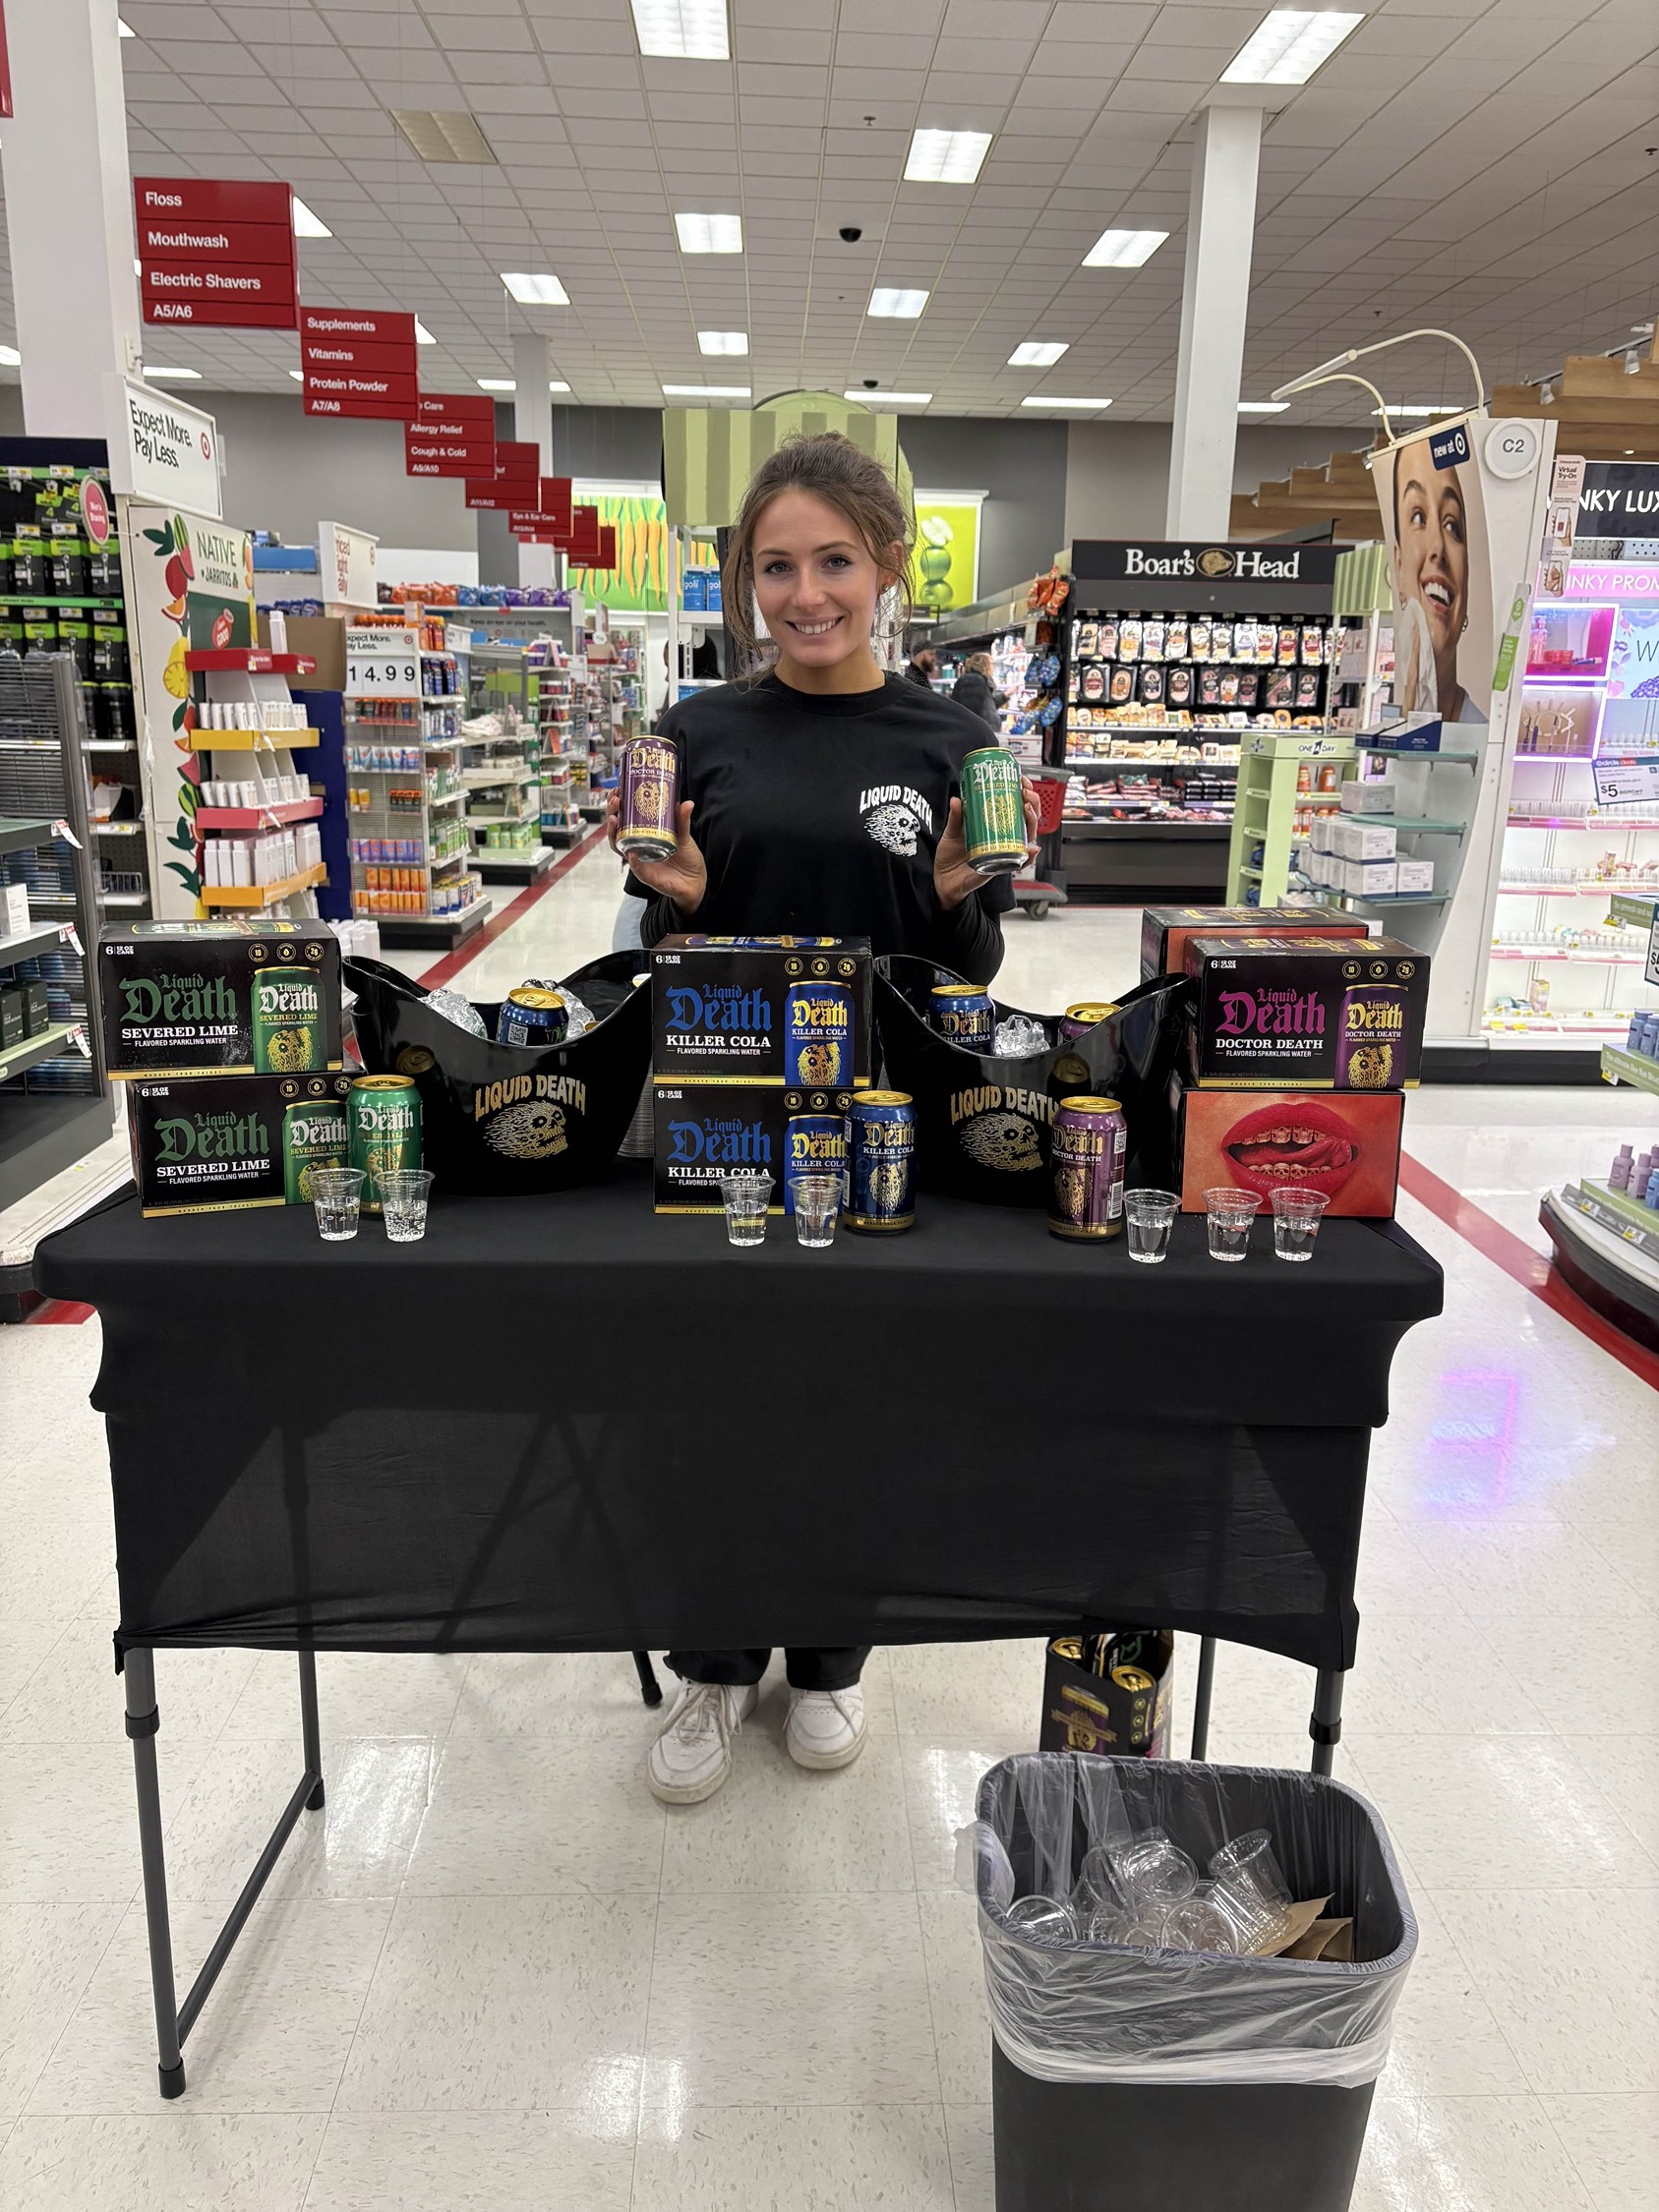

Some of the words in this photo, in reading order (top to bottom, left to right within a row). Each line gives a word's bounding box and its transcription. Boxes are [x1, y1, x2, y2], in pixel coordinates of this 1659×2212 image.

[146, 191, 182, 206] Floss
[148, 232, 228, 248] Mouthwash
[150, 271, 203, 287] Electric
[206, 273, 261, 290] Shavers
[153, 304, 193, 319] A5/A6
[307, 318, 376, 332] Supplements
[308, 348, 354, 361] Vitamins
[309, 378, 347, 390] Protein
[348, 379, 388, 392] Powder
[312, 400, 341, 412] A7/A8
[129, 399, 164, 437] Expect
[165, 415, 193, 447] More.
[410, 424, 439, 435] Allergy
[440, 425, 463, 435] Relief
[135, 430, 152, 462] Pay
[154, 439, 179, 468] Less.
[411, 446, 439, 457] Cough
[440, 447, 446, 456] &
[446, 448, 467, 457] Cold
[1434, 444, 1447, 458] new
[1447, 439, 1455, 453] at
[1503, 438, 1524, 453] C2
[1579, 489, 1622, 511] NKY
[197, 531, 237, 566] NATIVE
[1124, 548, 1195, 576] Boar's
[1234, 551, 1300, 579] Head
[205, 566, 232, 587] JARRITOS
[1566, 574, 1609, 591] INKY
[683, 580, 699, 590] goli
[709, 579, 721, 591] gol
[346, 634, 368, 644] xpect
[1600, 784, 1619, 797] $5
[859, 785, 902, 814] LIQUID
[903, 786, 933, 835] DEATH
[105, 946, 114, 955] 6
[160, 973, 204, 990] Liquid
[278, 983, 303, 992] Liquid
[119, 975, 238, 1023] Death
[259, 985, 319, 1014] Death
[702, 984, 741, 1000] Liquid
[1256, 987, 1297, 1004] Liquid
[665, 985, 773, 1031] Death
[810, 998, 834, 1008] Liquid
[1366, 1001, 1391, 1010] Liquid
[792, 1000, 848, 1026] Death
[1215, 990, 1326, 1035] Death
[1345, 1002, 1403, 1029] Death
[940, 1010, 990, 1036] Death
[122, 1026, 196, 1039] SEVERED
[199, 1024, 238, 1036] LIME
[667, 1035, 726, 1047] KILLER
[730, 1036, 771, 1047] COLA
[1215, 1038, 1272, 1049] DOCTOR
[1275, 1039, 1324, 1049] DEATH
[142, 1088, 149, 1097] 6
[474, 1075, 532, 1122] LIQUID
[536, 1075, 587, 1116] DEATH
[658, 1090, 665, 1099] 6
[950, 1085, 1002, 1126] LIQUID
[1006, 1087, 1059, 1126] DEATH
[195, 1111, 236, 1128] Liquid
[309, 1117, 332, 1126] Liquid
[358, 1103, 414, 1131] Death
[703, 1117, 741, 1133] Liquid
[154, 1113, 270, 1162] Death
[290, 1118, 348, 1146] Death
[810, 1131, 833, 1139] Liquid
[862, 1121, 915, 1146] Death
[1052, 1125, 1103, 1154] Death
[667, 1119, 772, 1164] Death
[791, 1134, 846, 1159] Death
[290, 1145, 327, 1155] SEVERED
[156, 1163, 230, 1178] SEVERED
[232, 1159, 270, 1171] LIME
[668, 1167, 727, 1178] KILLER
[730, 1167, 770, 1177] COLA
[169, 1175, 202, 1185] FLAVORED
[203, 1173, 237, 1183] SPARKLING
[238, 1171, 260, 1180] WATER
